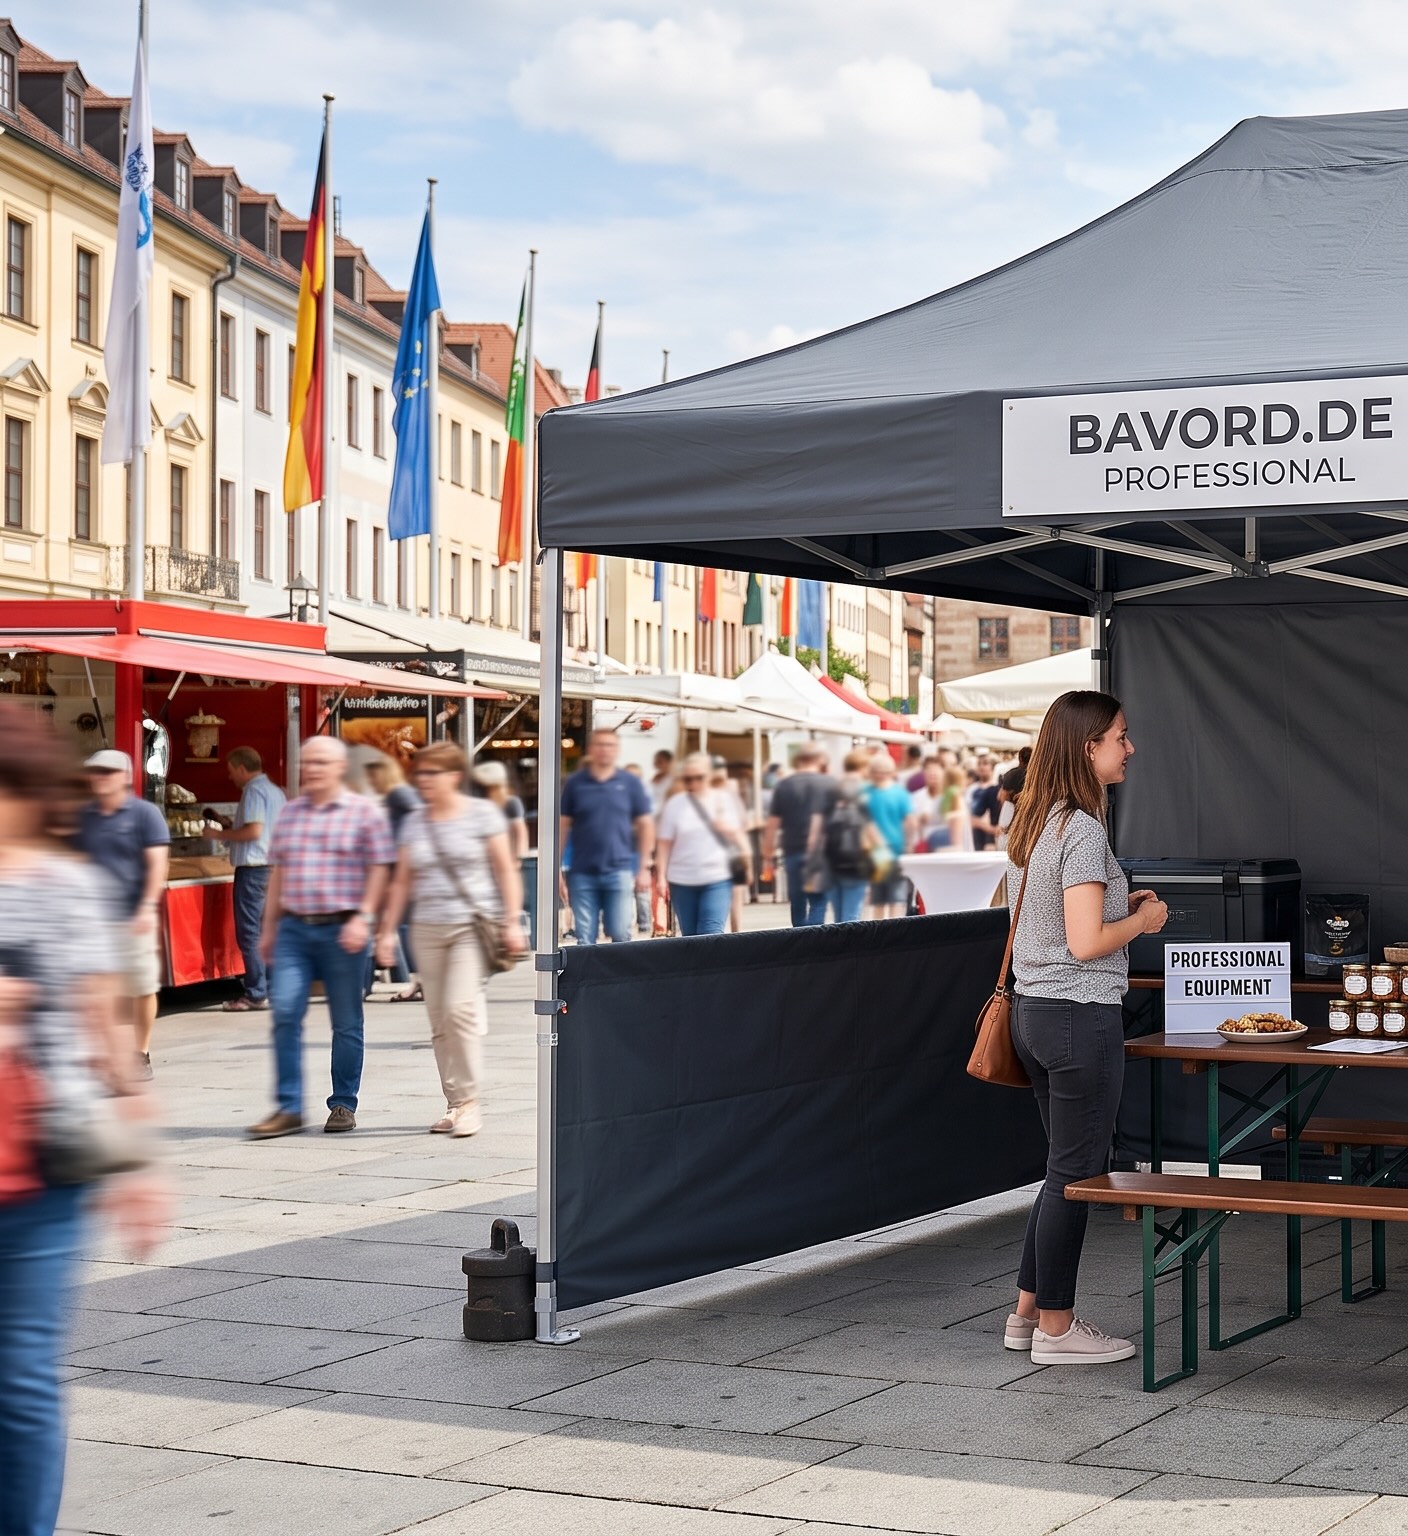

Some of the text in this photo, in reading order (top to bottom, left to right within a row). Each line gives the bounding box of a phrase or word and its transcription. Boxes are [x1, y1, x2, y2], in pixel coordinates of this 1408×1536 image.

[1069, 397, 1394, 455] BAVORD.DE
[1104, 457, 1356, 493] PROFESSIONAL
[1171, 950, 1285, 968] PROFESSIONAL
[1184, 978, 1272, 997] EQUIPMENT
